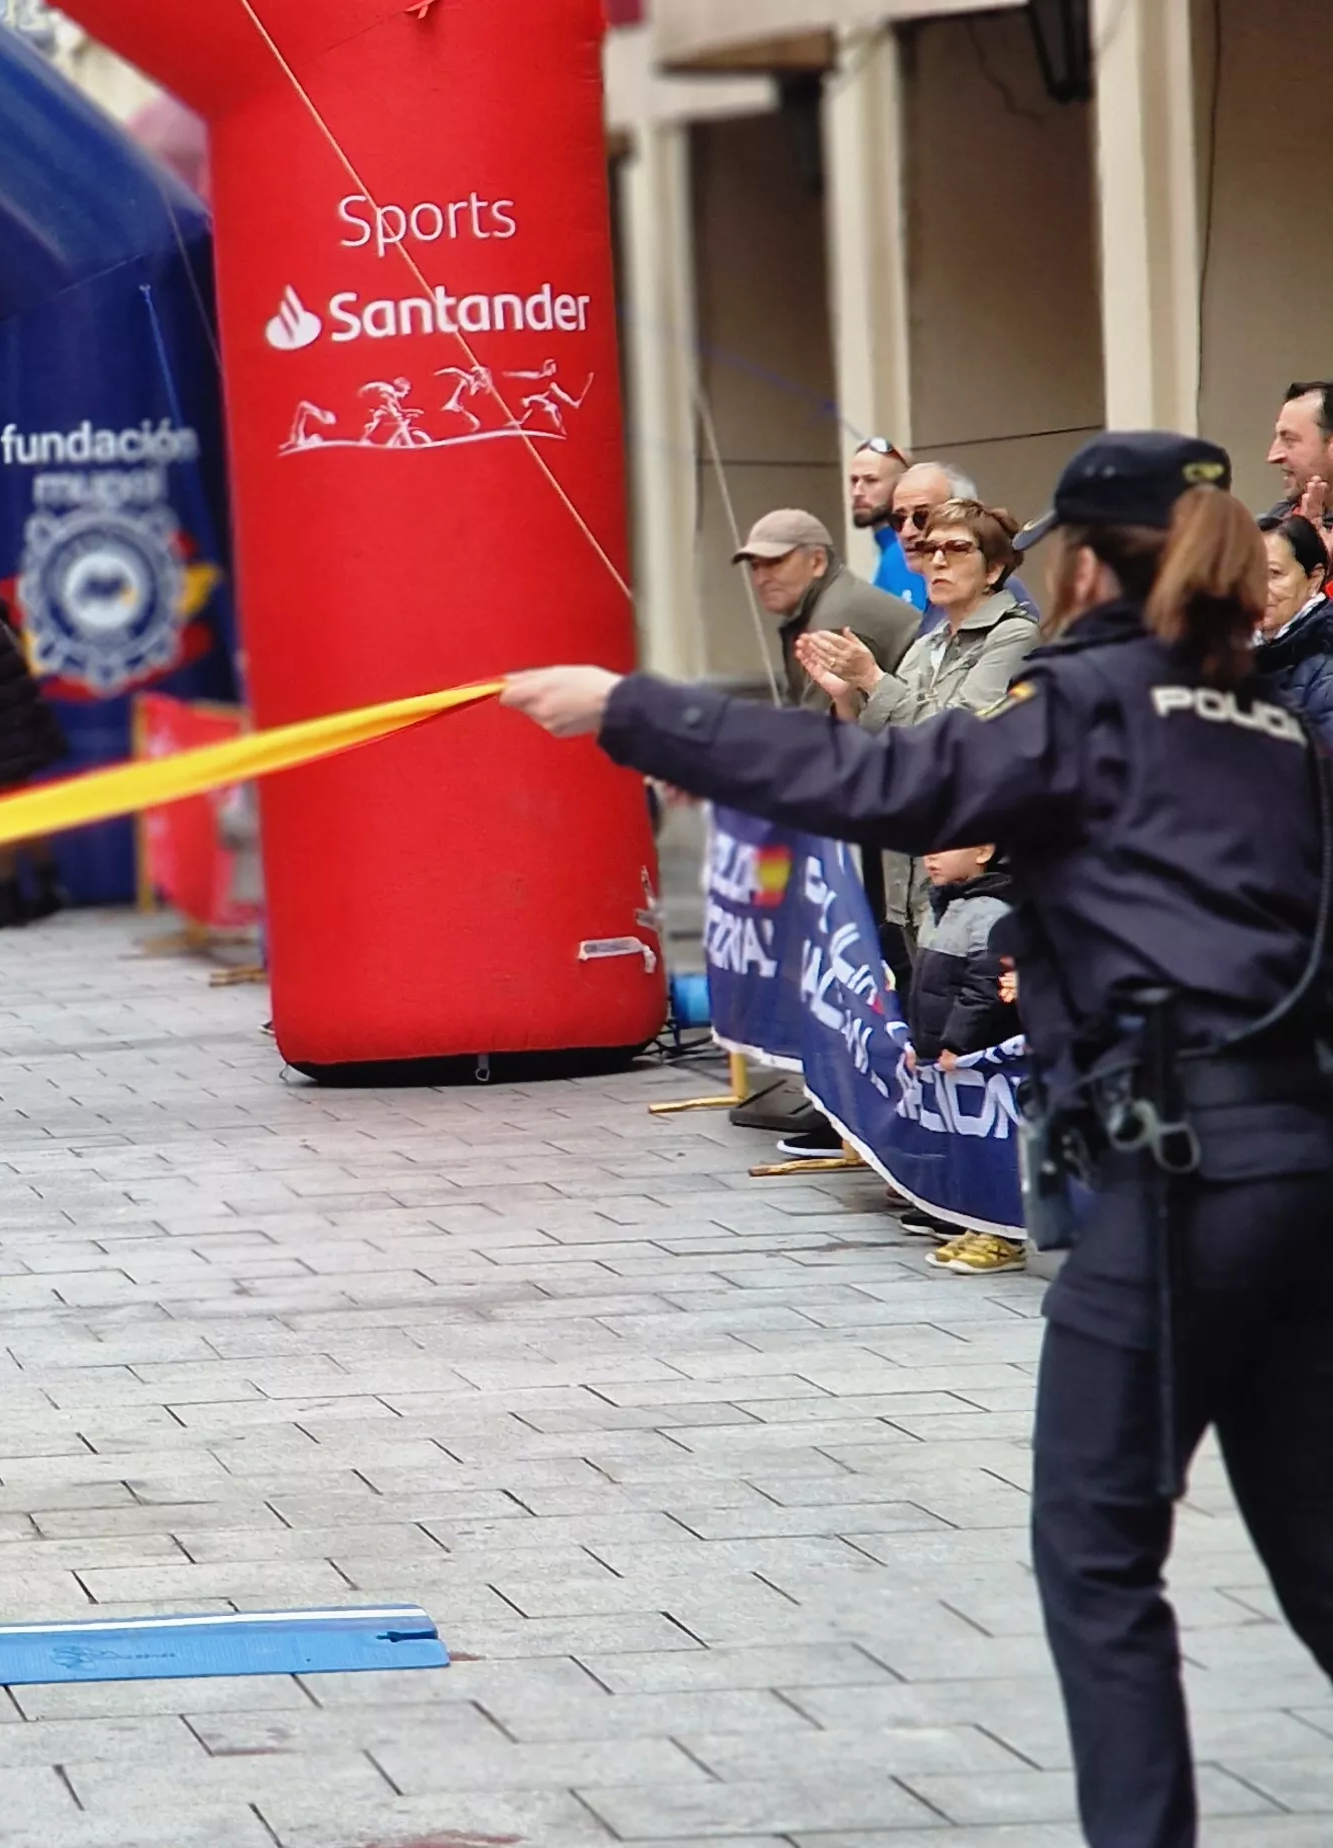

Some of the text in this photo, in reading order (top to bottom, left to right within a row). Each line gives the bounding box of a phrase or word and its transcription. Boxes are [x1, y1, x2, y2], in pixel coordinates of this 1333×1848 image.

[337, 192, 518, 258] Sports
[329, 283, 590, 342] Santander
[1, 418, 197, 464] fundación
